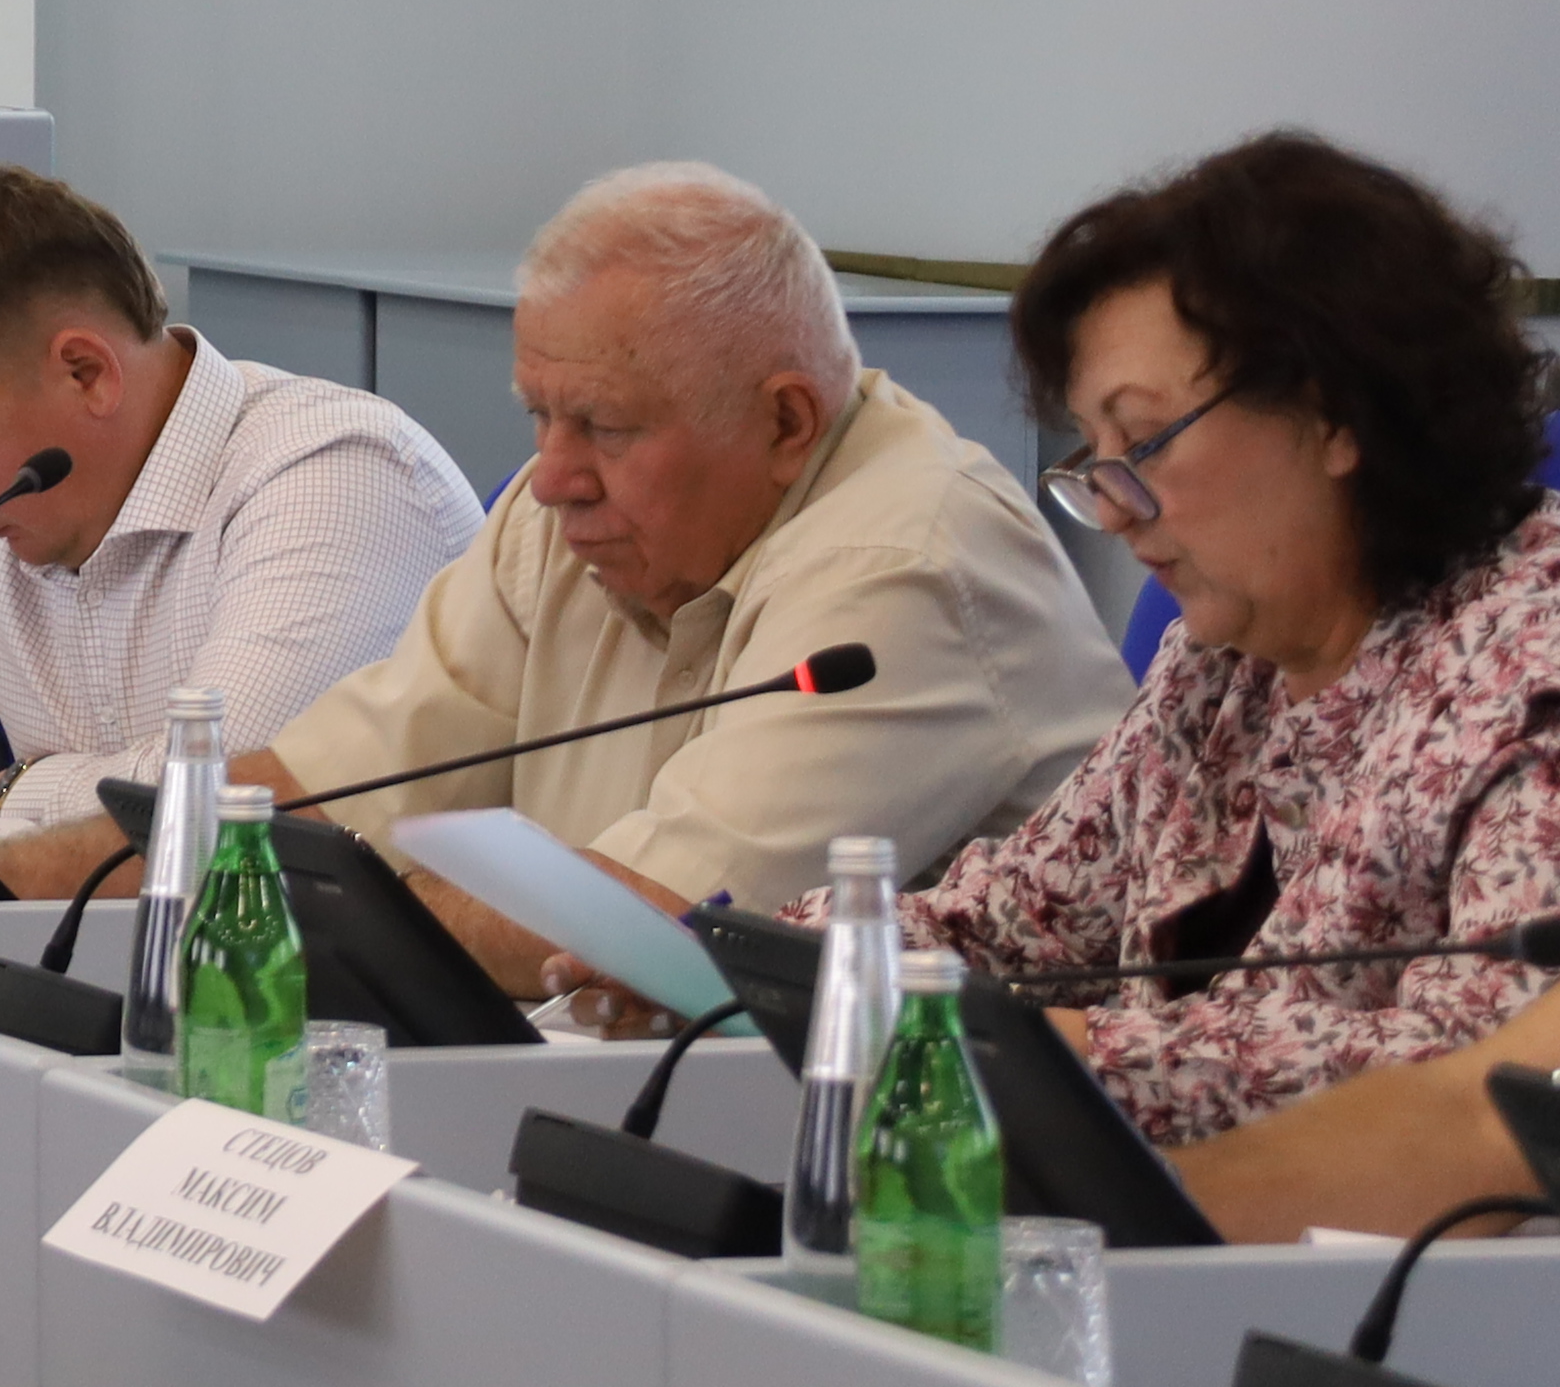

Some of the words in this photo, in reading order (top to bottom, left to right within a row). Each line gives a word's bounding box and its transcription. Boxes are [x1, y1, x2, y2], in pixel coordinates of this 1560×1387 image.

[222, 1127, 329, 1175] СТЕЦОВ
[171, 1166, 288, 1226] МАКСИМ
[91, 1201, 287, 1288] ВЛАДИМИРОВИЧ
